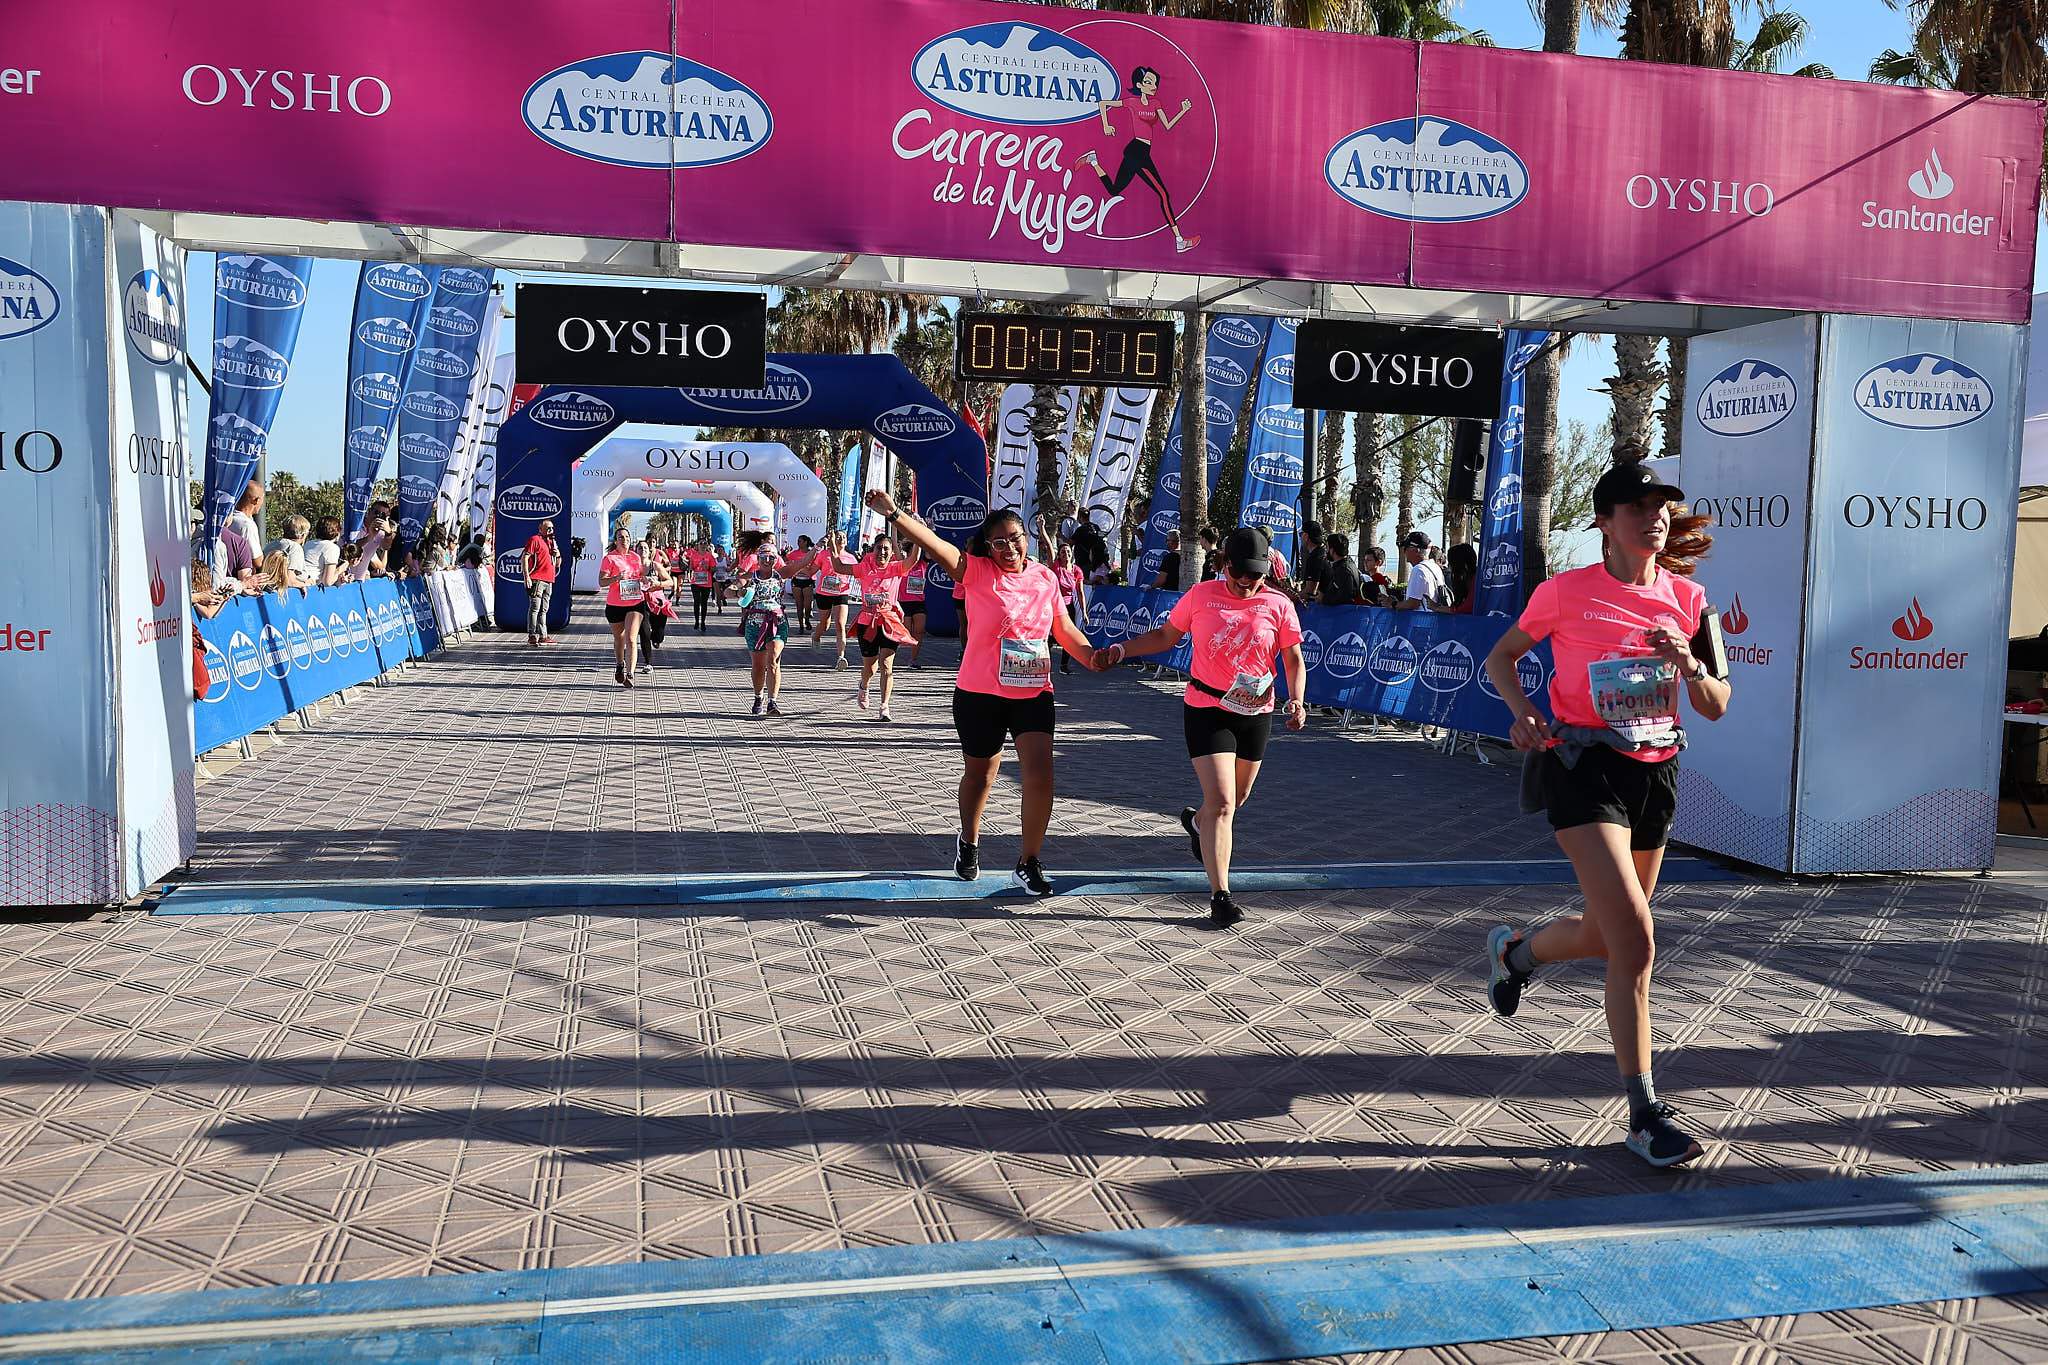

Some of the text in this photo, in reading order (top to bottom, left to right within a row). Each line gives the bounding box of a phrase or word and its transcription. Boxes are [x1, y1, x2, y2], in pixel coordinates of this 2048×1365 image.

[961, 52, 1099, 74] CENTRAL LECHERA
[182, 64, 393, 117] OYSHO
[928, 52, 1103, 104] ASTURIANA
[581, 87, 660, 103] CENTRAL
[541, 88, 755, 143] ASTURIANA
[892, 109, 1061, 172] Carrera
[1373, 149, 1509, 169] CENTRAL LECHERA
[1340, 149, 1513, 199] ASTURIANA
[933, 167, 1124, 253] de la Mujer
[1626, 174, 1775, 217] OYSHO
[1861, 201, 1995, 236] Santander
[430, 316, 474, 333] STURIANA
[558, 317, 731, 359] OYSHO
[972, 324, 1158, 376] 00:43:16
[767, 375, 798, 383] CHERA
[1207, 366, 1242, 384] STURIANA
[1330, 350, 1473, 389] OYSHO
[1702, 392, 1789, 421] ASTURIANA
[1863, 379, 1982, 412] ASTURIANA
[534, 404, 608, 422] ASTURIANA
[881, 418, 951, 433] ASTURIANA
[1261, 412, 1304, 431] ASTURIA
[129, 433, 183, 479] OYSHO
[646, 447, 750, 471] OYSHO
[997, 408, 1031, 511] YSHO
[583, 469, 615, 478] OYSHO
[778, 473, 809, 481] OYSHO
[1252, 461, 1304, 481] ASTURIAN
[500, 497, 558, 513] ASTURIANA
[1693, 494, 1791, 529] OYSHO
[1844, 494, 1988, 531] OYSHO
[137, 615, 181, 645] Santander
[1723, 640, 1773, 666] ander
[1849, 646, 1969, 671] Santander
